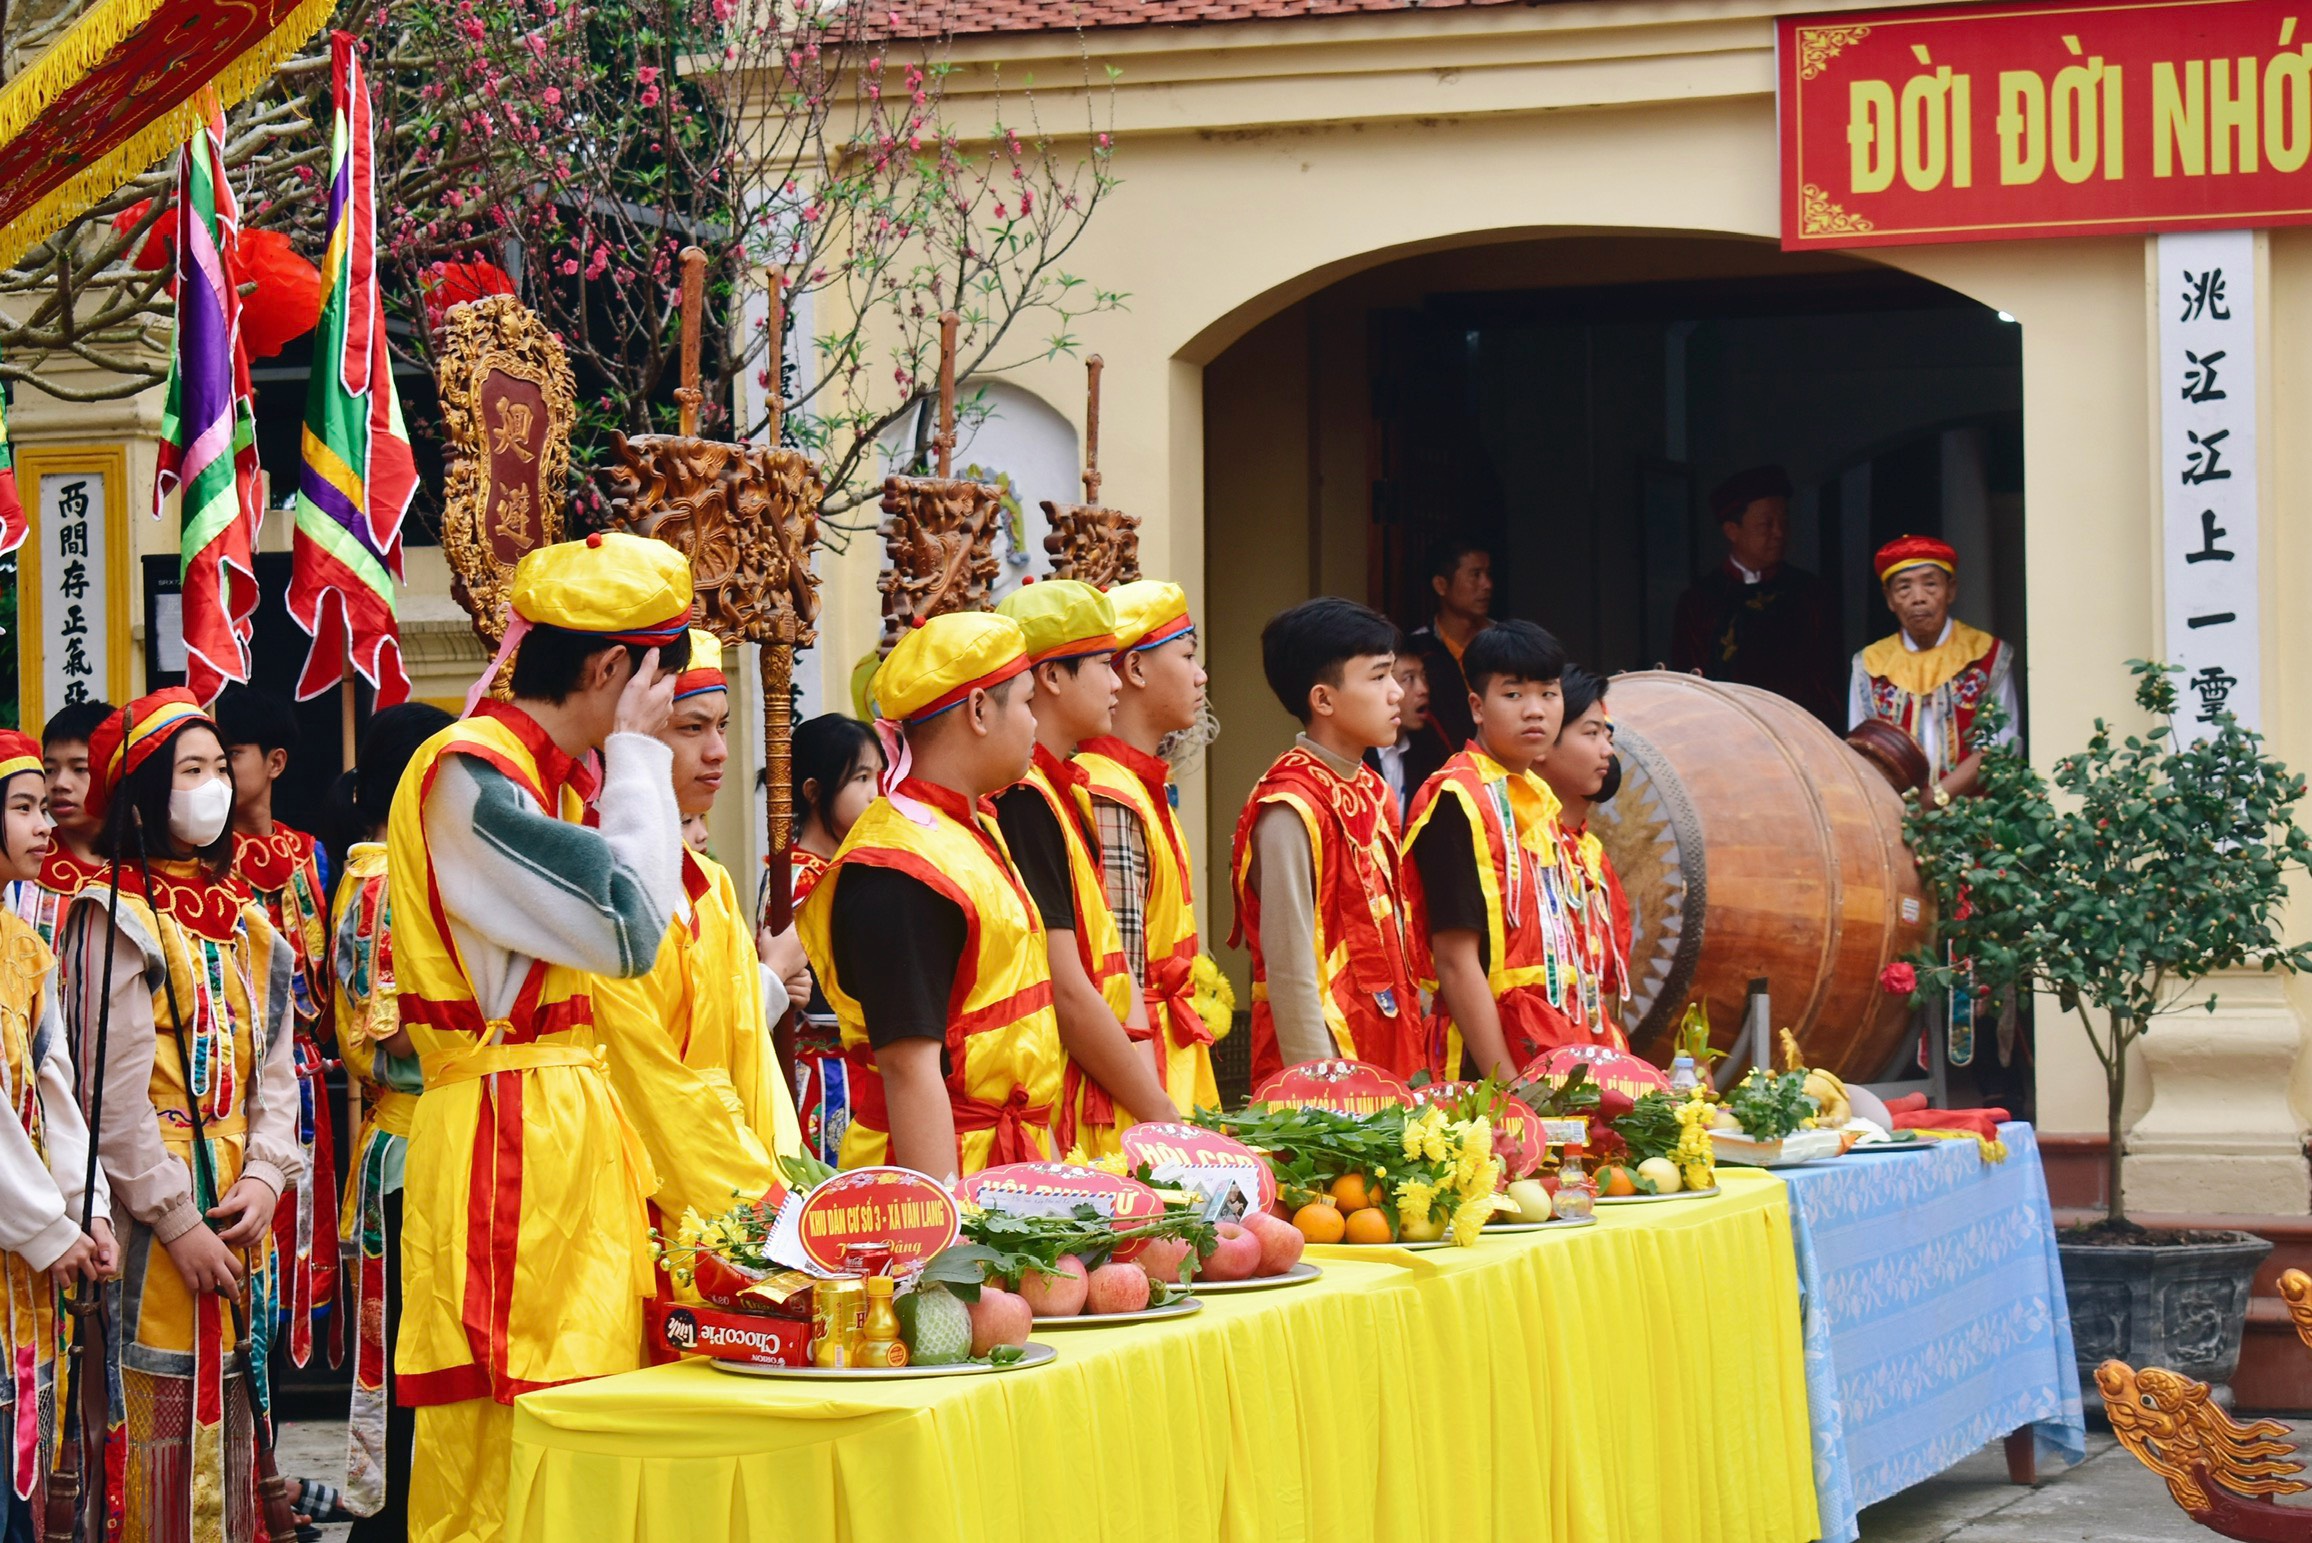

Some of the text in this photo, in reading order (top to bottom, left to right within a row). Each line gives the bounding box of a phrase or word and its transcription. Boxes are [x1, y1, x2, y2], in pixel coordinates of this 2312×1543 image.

[1847, 16, 2312, 193] ĐỜI ĐỜI NHỚ
[809, 1209, 827, 1237] KHU
[827, 1203, 846, 1235] DÂN
[848, 1204, 861, 1234] CƯ
[861, 1196, 873, 1233] SỐ
[875, 1206, 881, 1232] 3
[887, 1199, 901, 1231] XÃ
[901, 1197, 920, 1229] VĂN
[921, 1200, 945, 1227] LANG
[751, 1354, 777, 1364] ORION
